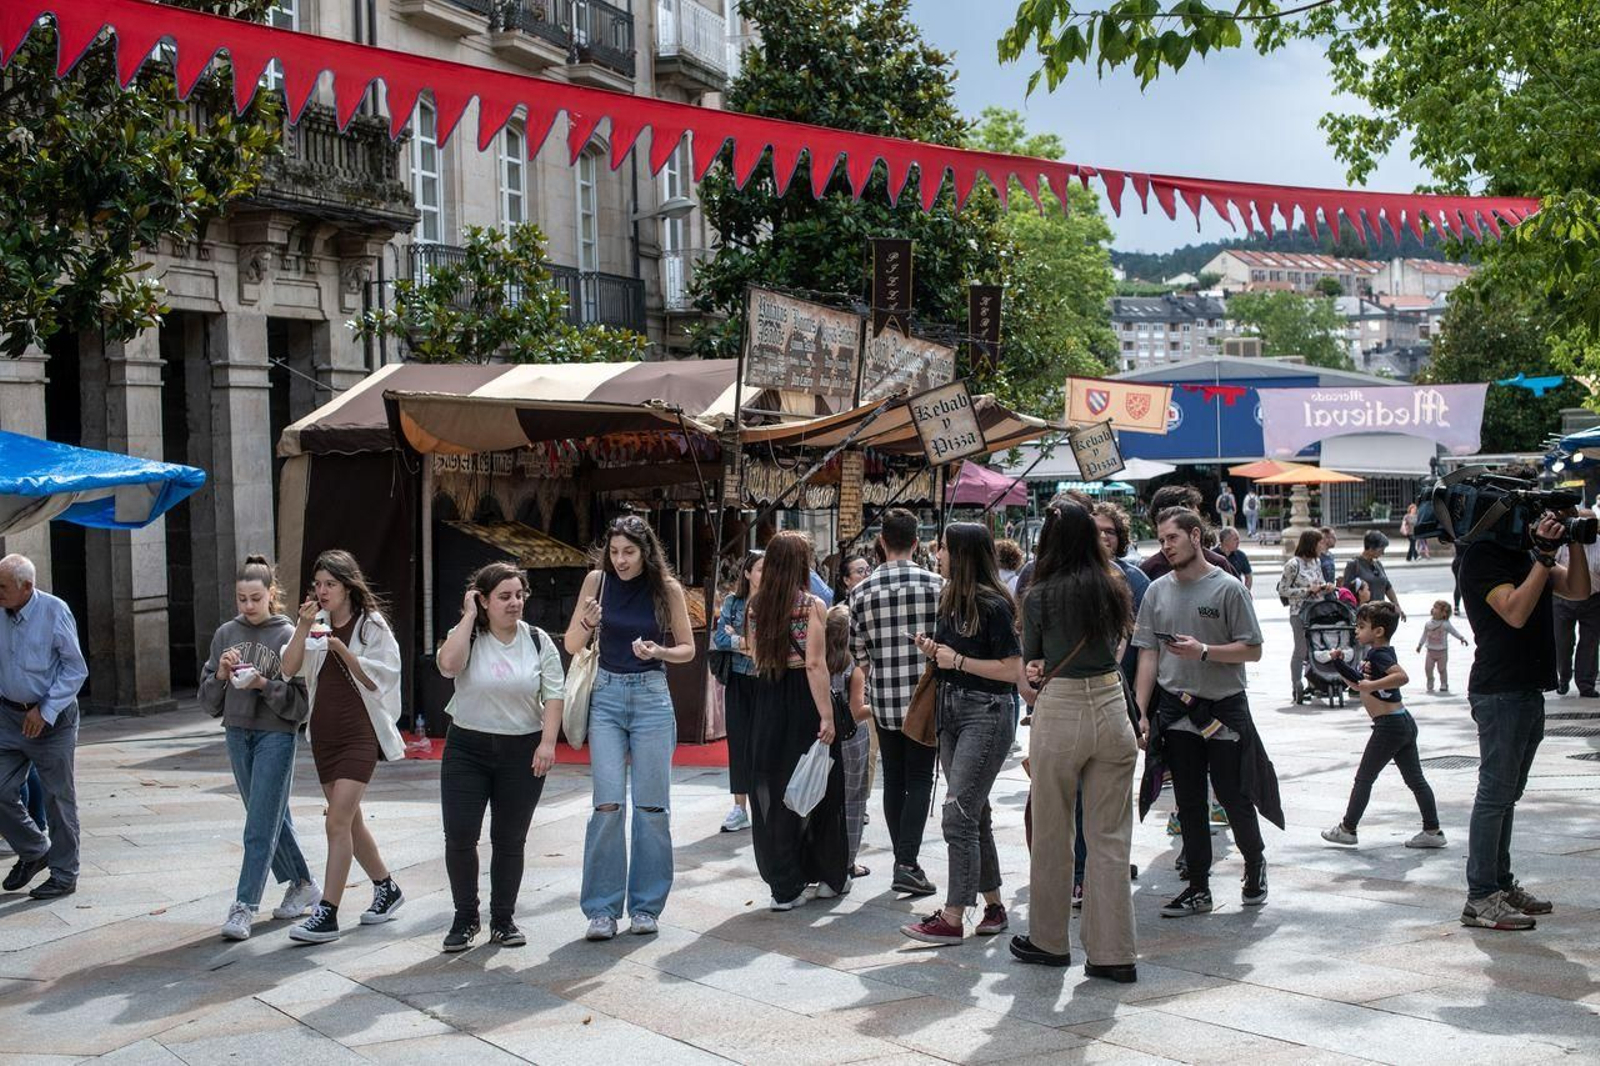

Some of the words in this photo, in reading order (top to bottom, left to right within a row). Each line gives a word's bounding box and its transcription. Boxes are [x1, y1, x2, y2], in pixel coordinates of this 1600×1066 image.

[913, 393, 968, 422] Kebab
[941, 417, 951, 430] y
[931, 431, 977, 458] Pizza
[1073, 430, 1111, 451] Kebab
[1086, 457, 1117, 477] Pizza
